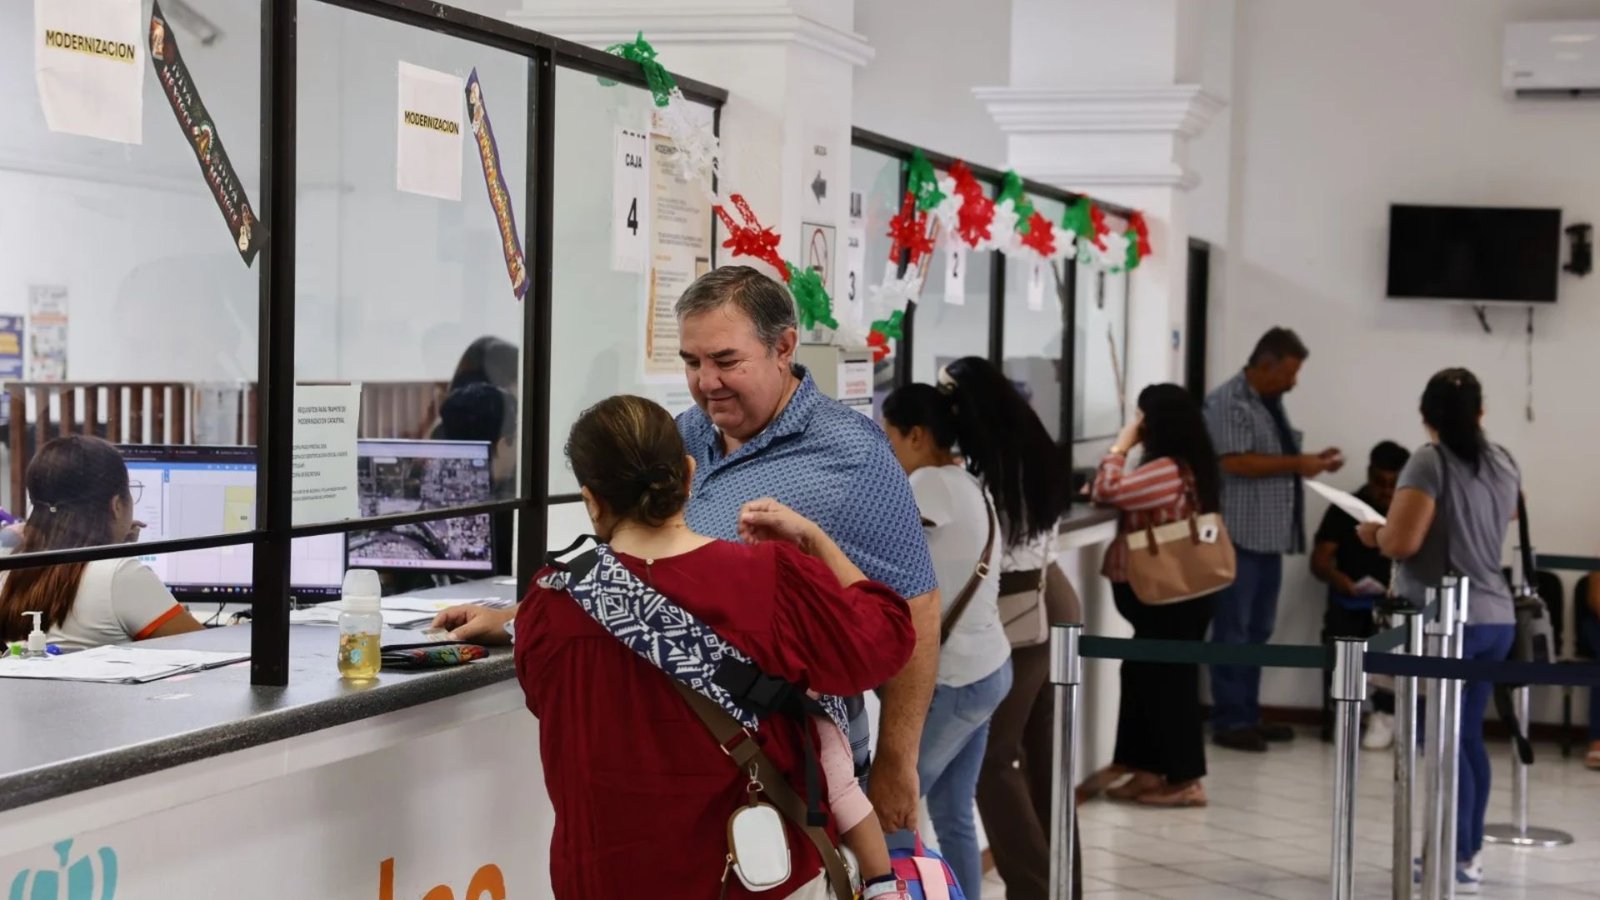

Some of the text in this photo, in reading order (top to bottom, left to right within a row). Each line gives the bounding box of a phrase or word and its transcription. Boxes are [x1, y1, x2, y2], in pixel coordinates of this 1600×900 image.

[45, 29, 136, 60] MODERNIZACION
[404, 110, 460, 135] MODERNIZACION
[625, 153, 643, 168] CAJA
[627, 197, 639, 236] 4
[953, 252, 959, 278] 2
[848, 270, 856, 302] 3
